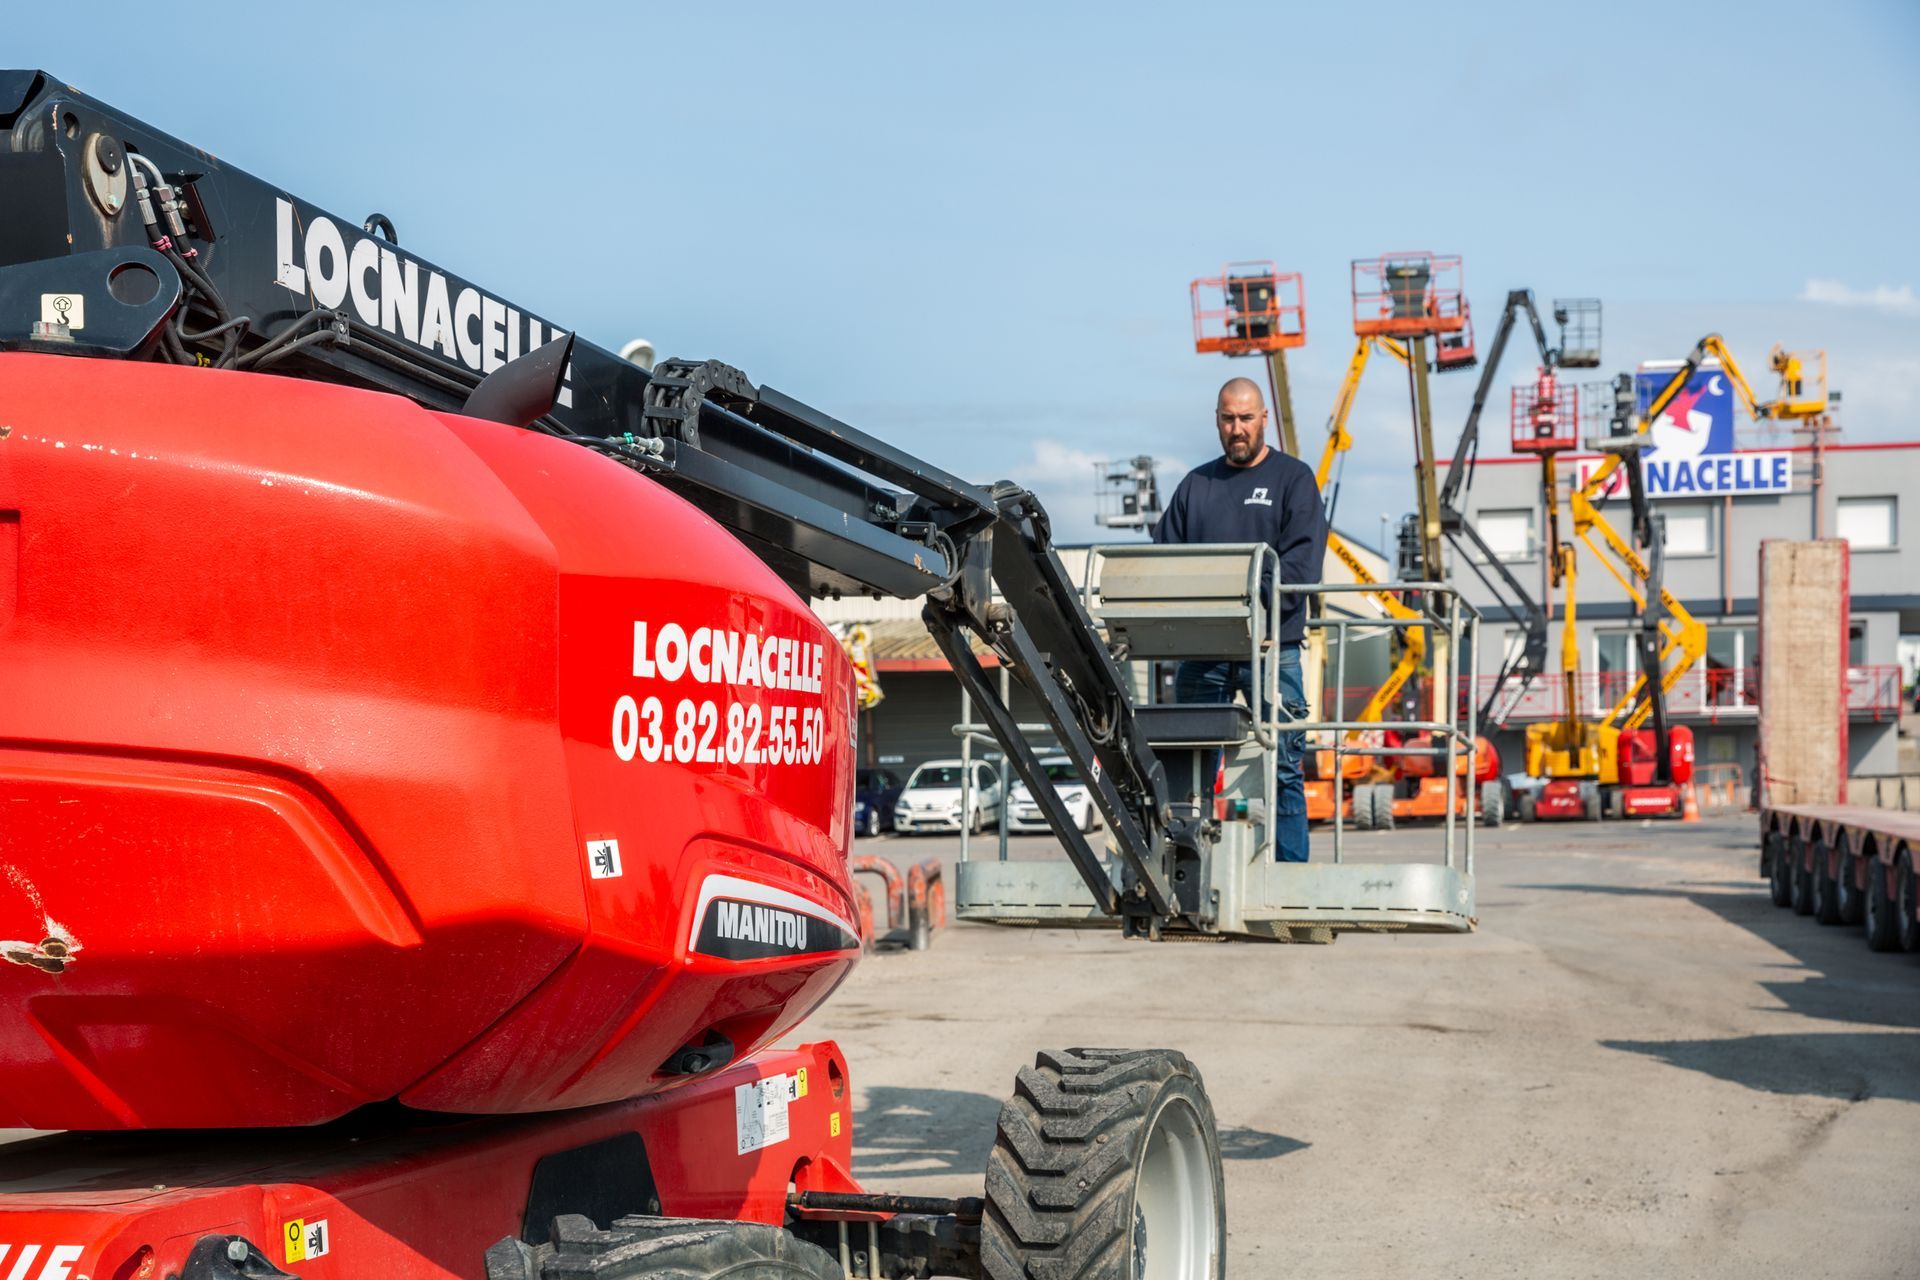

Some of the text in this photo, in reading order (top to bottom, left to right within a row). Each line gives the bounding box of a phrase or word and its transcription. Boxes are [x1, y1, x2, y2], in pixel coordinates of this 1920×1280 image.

[632, 620, 823, 694] LOCNACELLE
[611, 694, 823, 766] 03.82.82.55.50
[716, 900, 808, 951] MANITOU
